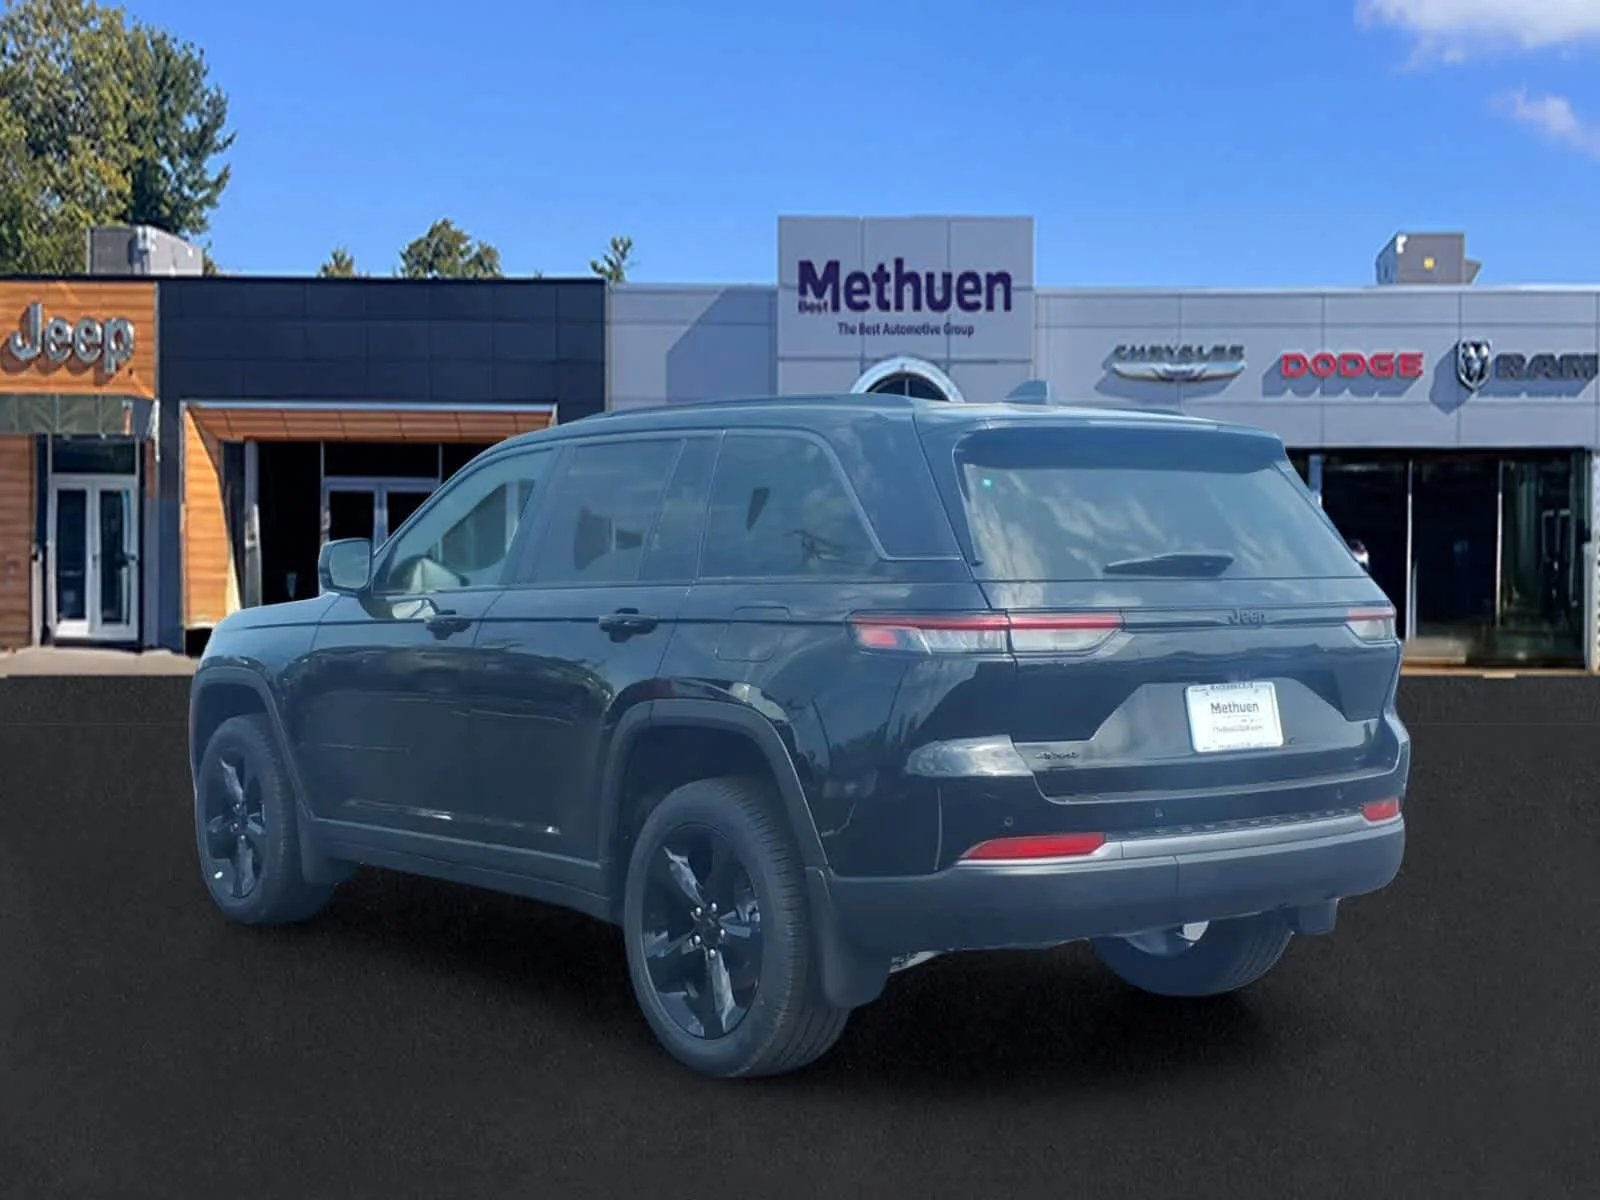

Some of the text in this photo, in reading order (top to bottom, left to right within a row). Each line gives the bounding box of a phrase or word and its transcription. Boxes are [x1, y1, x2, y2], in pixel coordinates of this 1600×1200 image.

[798, 257, 1012, 313] Methuen
[9, 303, 135, 374] Jeep
[838, 322, 975, 338] The Best Automotive Group
[1113, 344, 1244, 361] CHRYSLER
[1281, 352, 1424, 378] DODGE
[1495, 353, 1599, 380] RAM
[1210, 702, 1260, 715] Methuen
